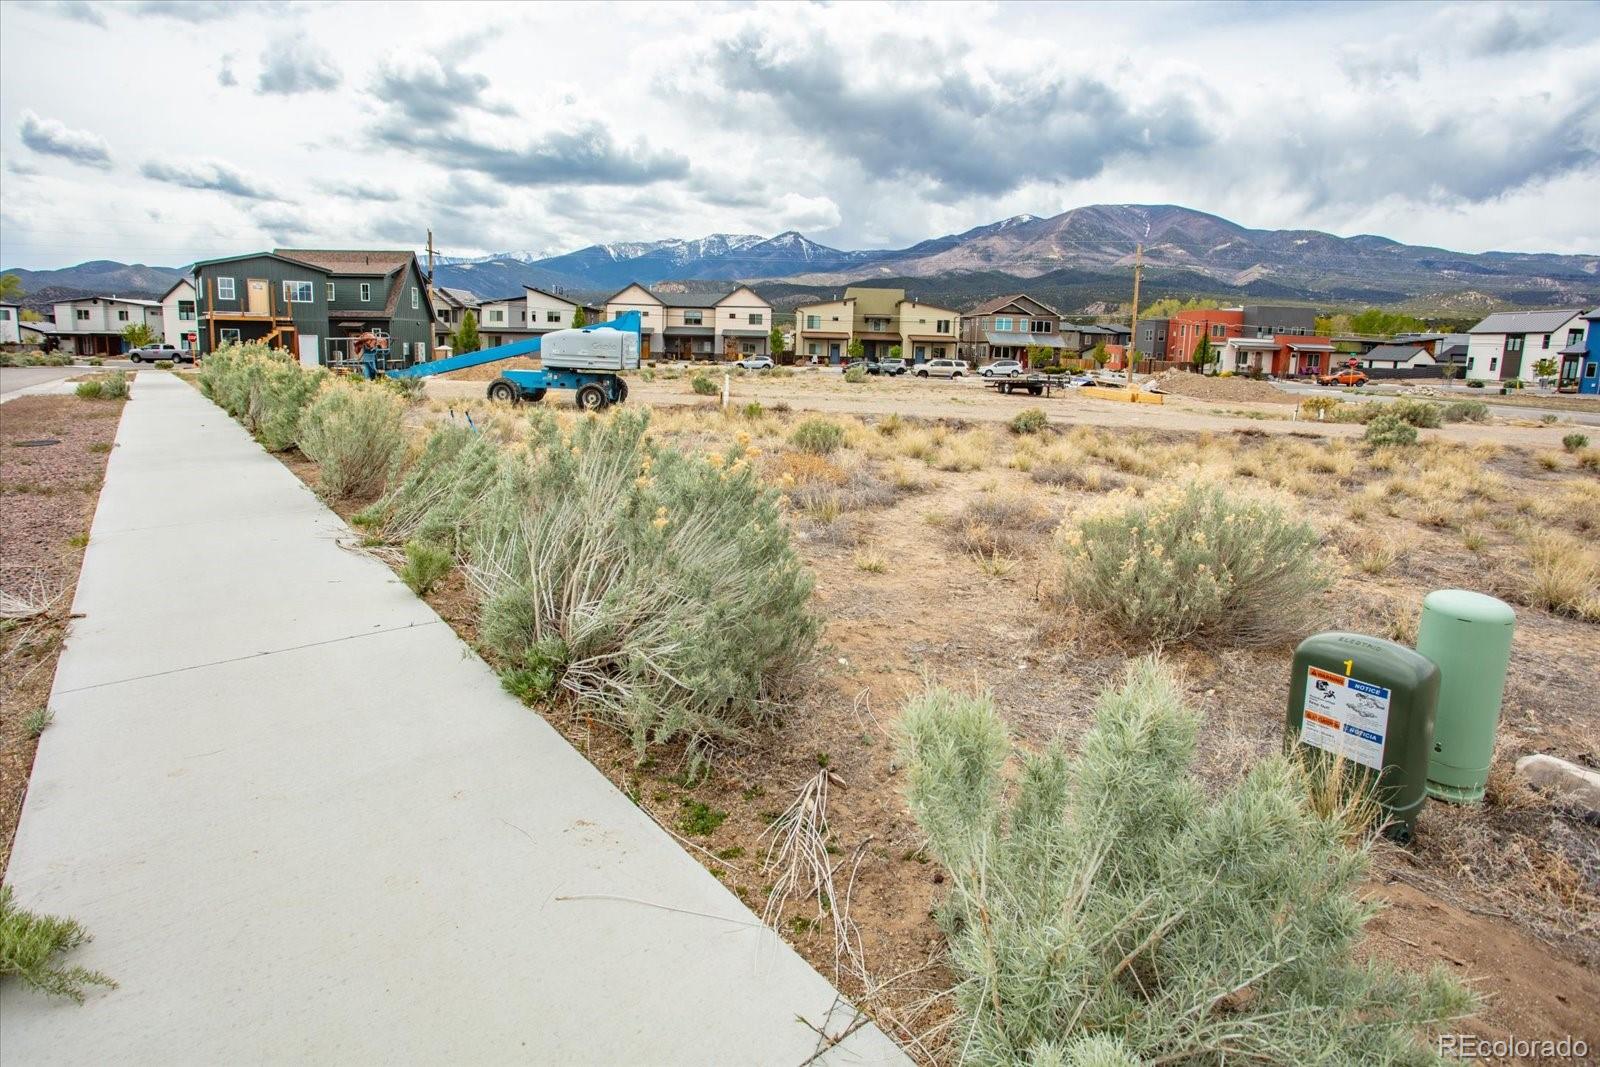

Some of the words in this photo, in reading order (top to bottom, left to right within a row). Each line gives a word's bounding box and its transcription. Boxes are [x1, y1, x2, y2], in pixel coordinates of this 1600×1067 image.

[1343, 659, 1353, 676] 1
[1354, 684, 1381, 696] NOTICE
[1349, 728, 1377, 741] NOTICIA
